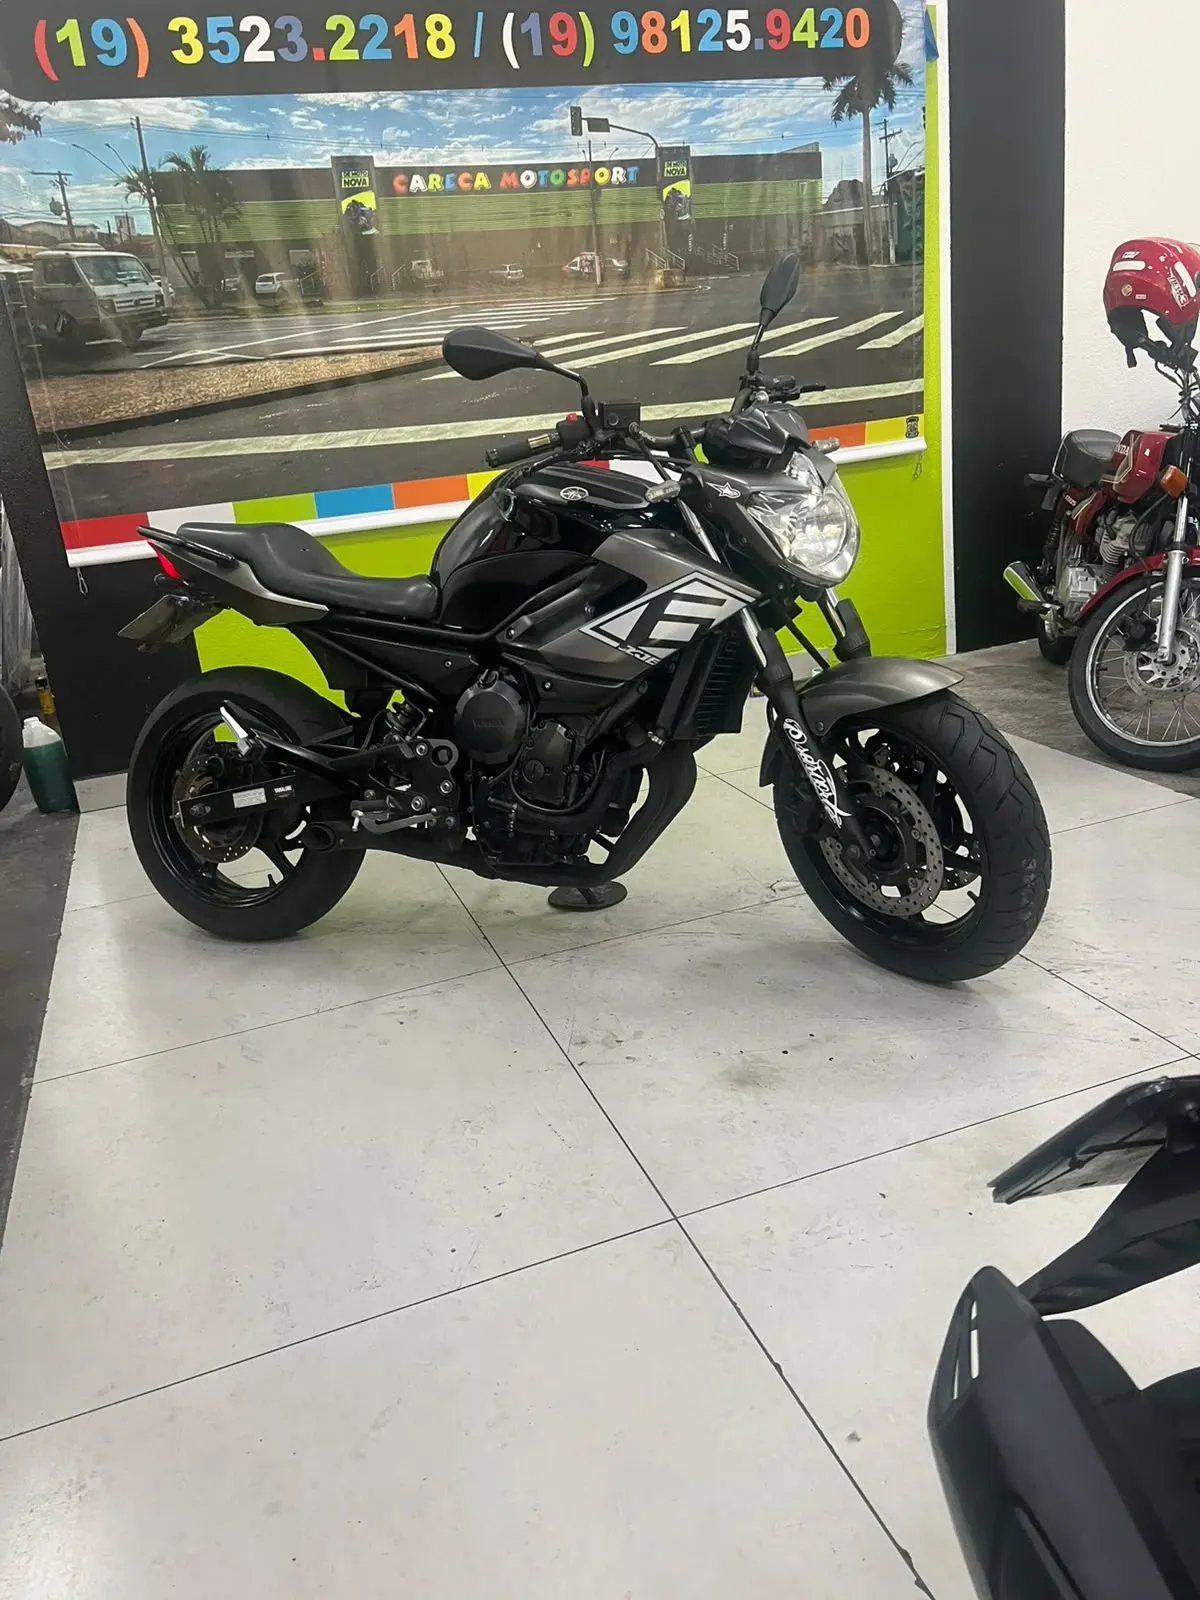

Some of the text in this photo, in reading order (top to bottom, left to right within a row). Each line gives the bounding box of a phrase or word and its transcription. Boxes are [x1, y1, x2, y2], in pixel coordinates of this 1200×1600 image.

[34, 17, 150, 81] (19)
[168, 13, 457, 64] 3523.2218
[502, 11, 595, 70] (19)
[610, 7, 870, 54] 98125.9420
[392, 166, 639, 193] CARECA MOTOSPORT
[666, 168, 685, 176] NOVA
[343, 178, 368, 187] NOVA
